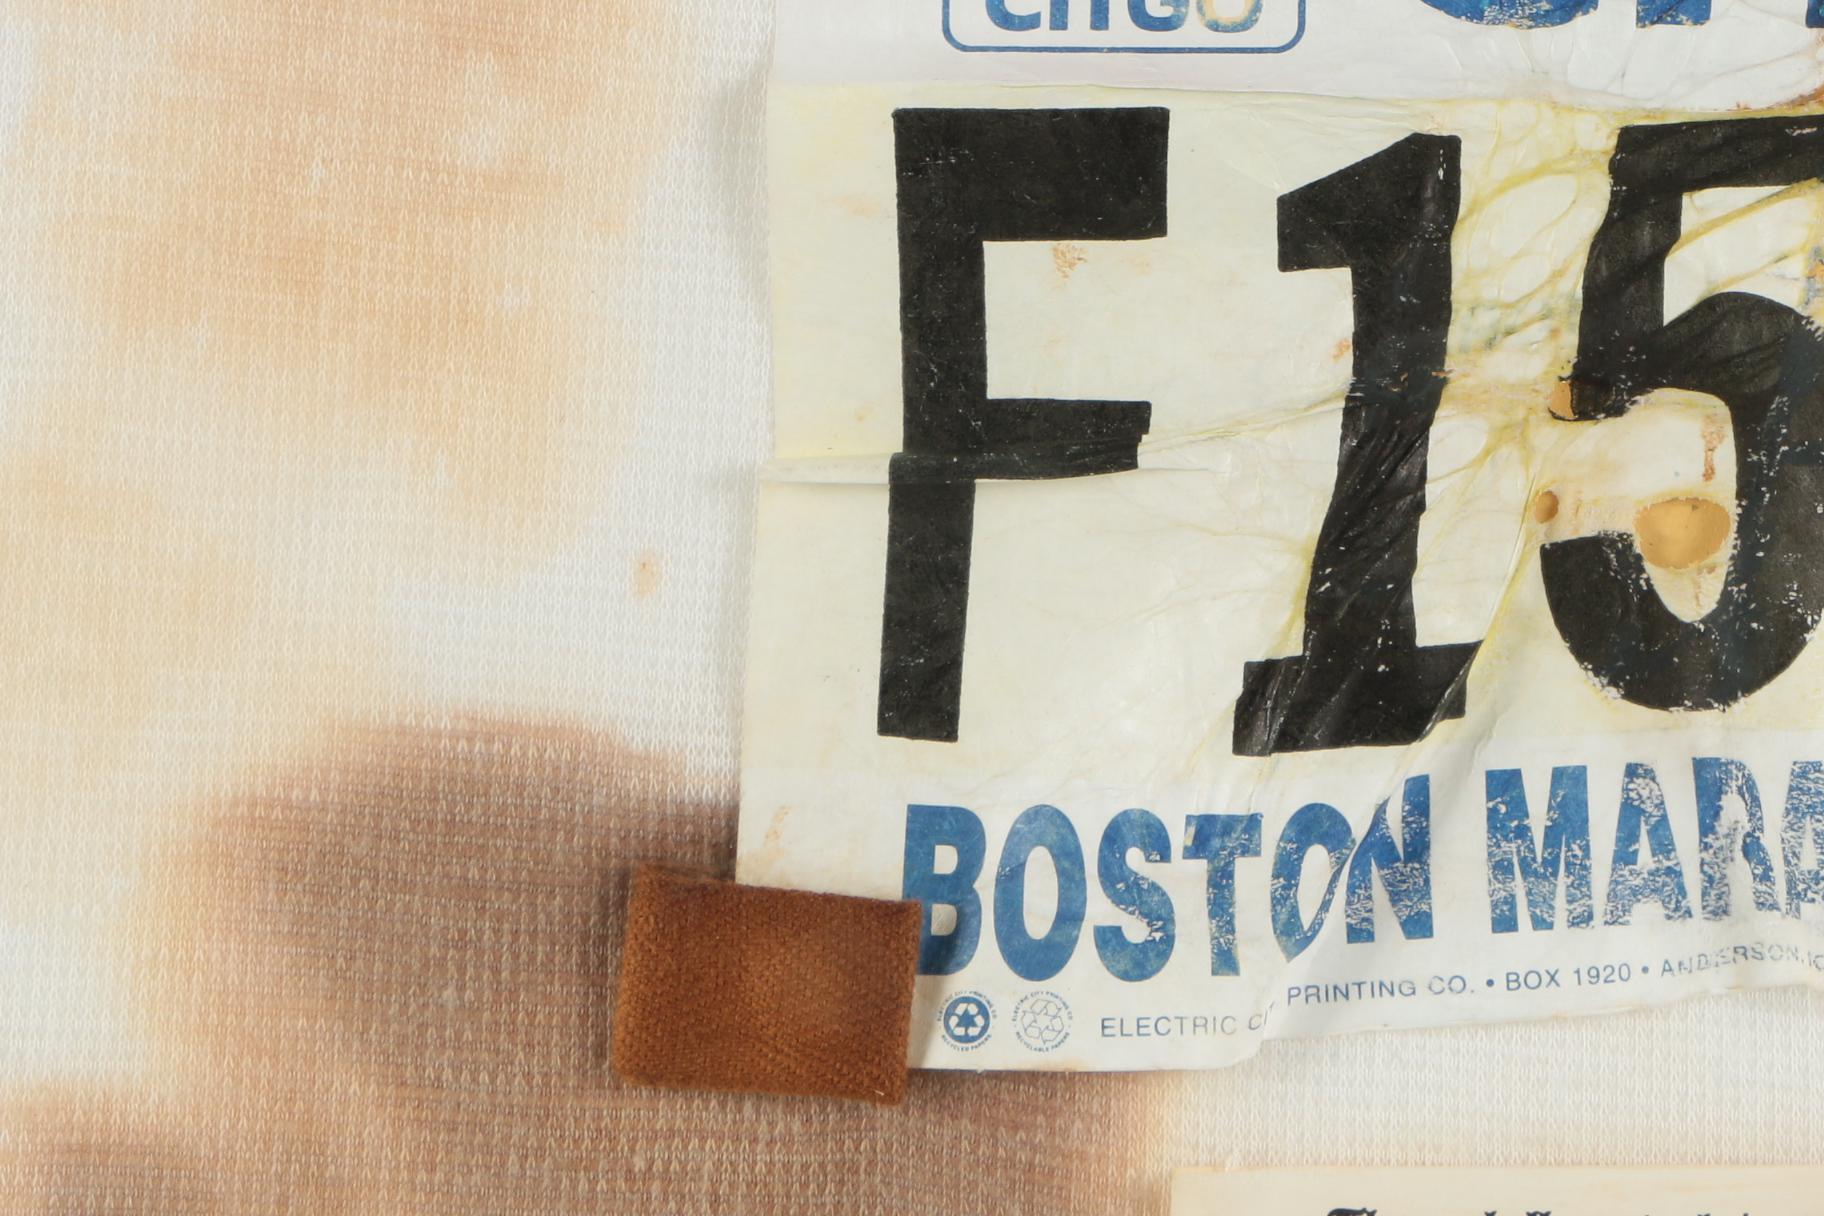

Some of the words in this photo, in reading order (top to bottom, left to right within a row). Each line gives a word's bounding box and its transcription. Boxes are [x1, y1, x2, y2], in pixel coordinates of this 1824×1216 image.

[903, 773, 1434, 982] BOSTON
[1101, 1015, 1237, 1038] ELECTRIC
[1287, 976, 1416, 1007] PRINTING
[1427, 974, 1474, 996] CO.
[1506, 969, 1561, 992] BOX
[1574, 962, 1632, 985] 1920
